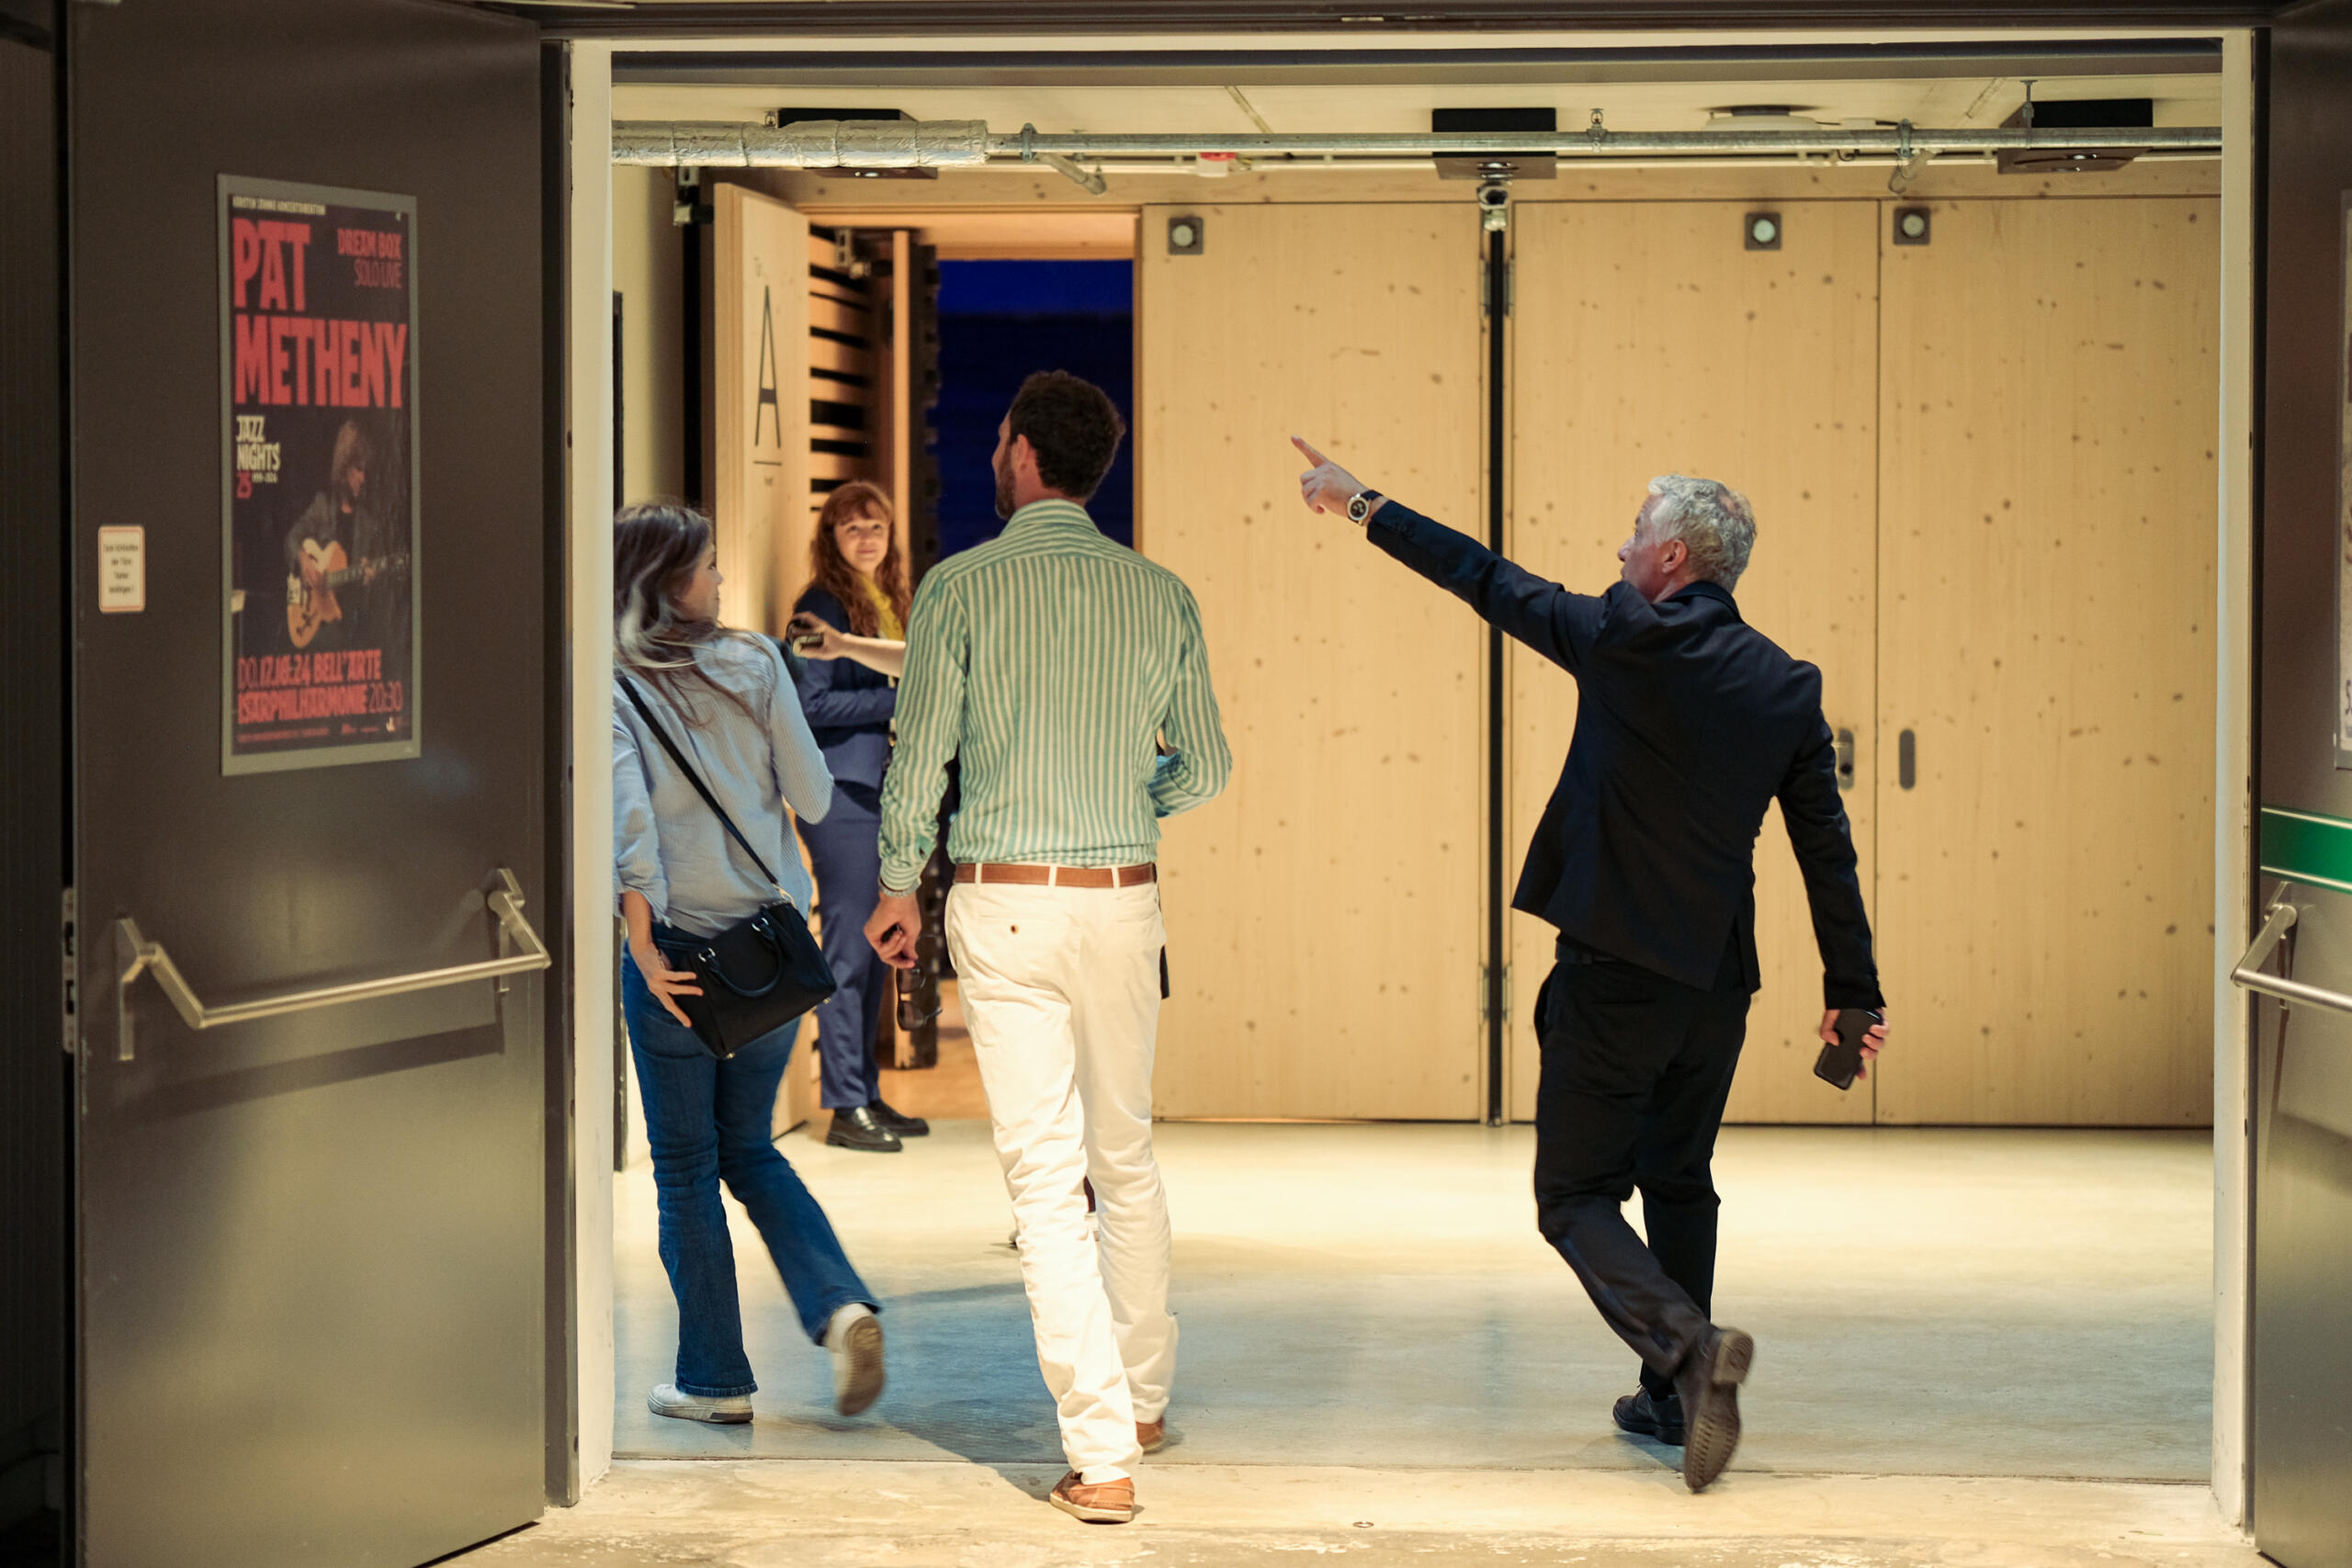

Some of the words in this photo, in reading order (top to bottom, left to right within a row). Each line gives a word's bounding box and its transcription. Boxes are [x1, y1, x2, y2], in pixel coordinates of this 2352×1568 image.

[232, 218, 311, 311] PAT
[337, 228, 376, 257] DREAM
[379, 231, 401, 259] BOX
[234, 314, 407, 409] METHENY
[754, 285, 782, 448] A
[235, 415, 266, 442] JAZZ
[237, 443, 281, 471] NIGHTS
